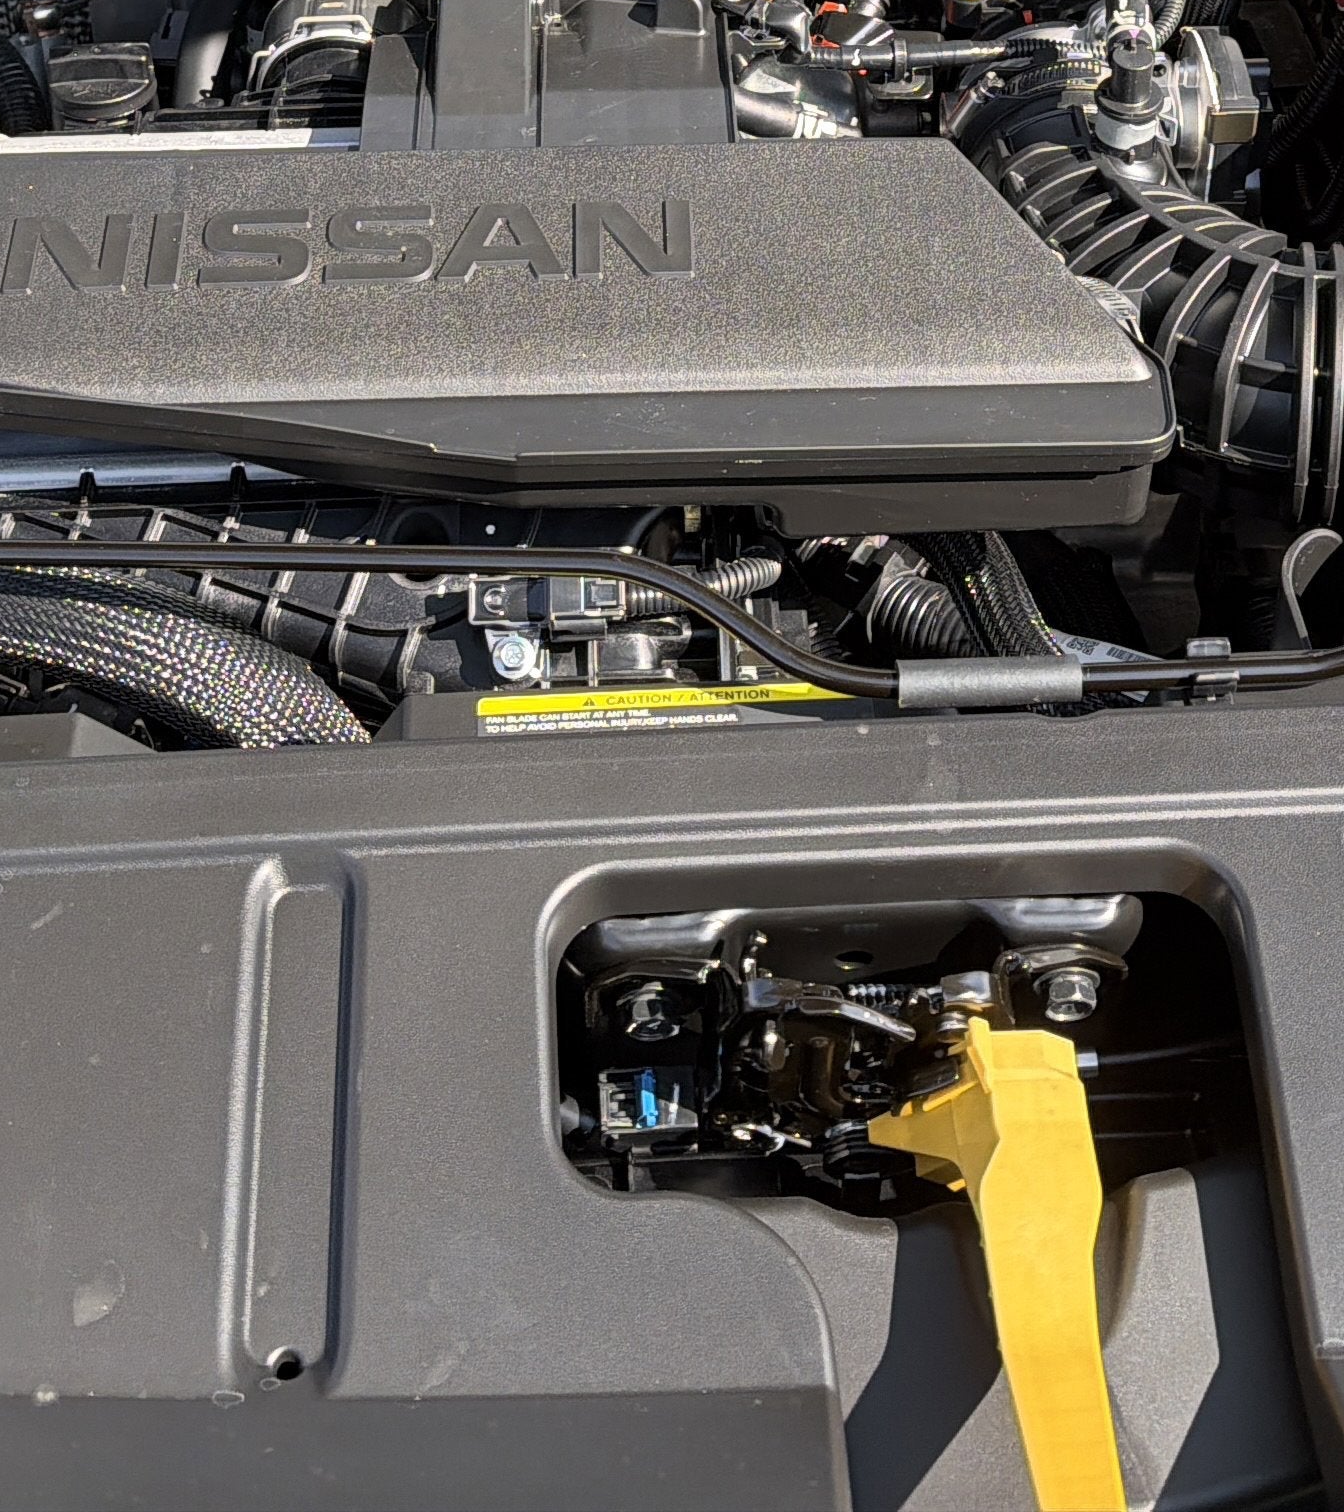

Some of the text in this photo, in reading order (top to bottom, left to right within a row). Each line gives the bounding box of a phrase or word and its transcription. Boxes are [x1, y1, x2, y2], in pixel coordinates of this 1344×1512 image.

[0, 200, 695, 294] NISSAN
[605, 694, 672, 706] CAUTION
[689, 689, 770, 702] ATTENTION
[486, 716, 505, 724] FAN
[506, 714, 537, 723] BLADE
[539, 713, 560, 721] CAN
[561, 712, 591, 720] START
[592, 711, 605, 719] AT
[607, 710, 626, 718] ANY
[486, 725, 500, 734] TO
[501, 724, 526, 733] HELP
[527, 722, 557, 732] AVOID
[558, 719, 610, 730] PERSONAL
[669, 714, 703, 724] HANDS
